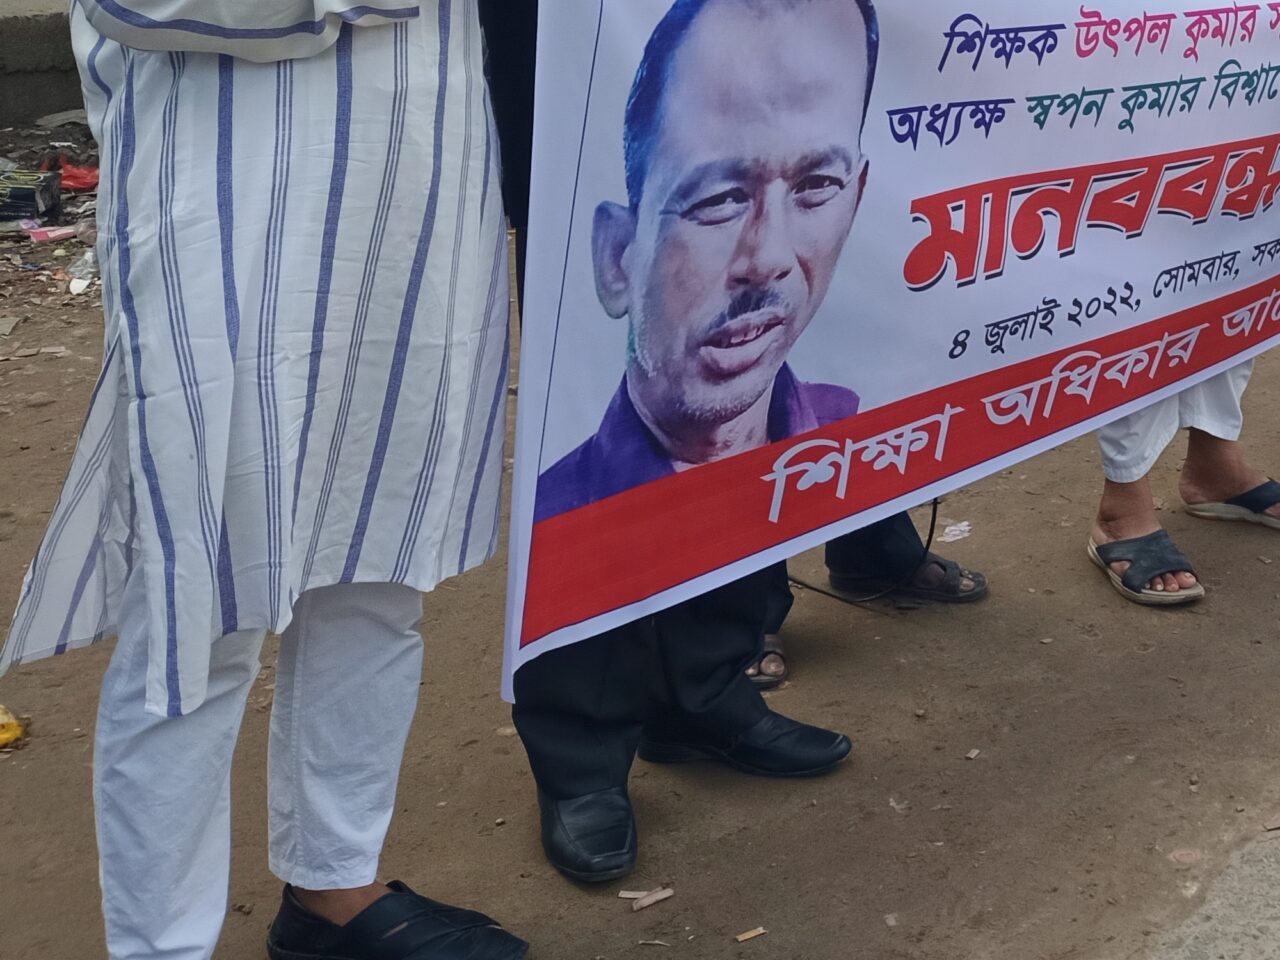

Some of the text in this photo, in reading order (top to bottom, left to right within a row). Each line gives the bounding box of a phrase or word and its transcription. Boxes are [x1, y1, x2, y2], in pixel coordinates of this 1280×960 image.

[937, 13, 1066, 73] শিক্ষক
[1074, 4, 1177, 58] উৎপল
[1183, 0, 1261, 63] কুমার
[886, 97, 1016, 152] অধ্যক্ষ
[1025, 85, 1115, 131] স্বপন
[1117, 74, 1207, 134] কুমার
[948, 329, 970, 359] ৪
[984, 296, 1061, 354] জুলাই
[1067, 281, 1142, 326] ২০২২,
[1153, 250, 1241, 298] সোমবার,
[760, 403, 966, 523] শিক্ষা
[981, 322, 1209, 427] অধিকার
